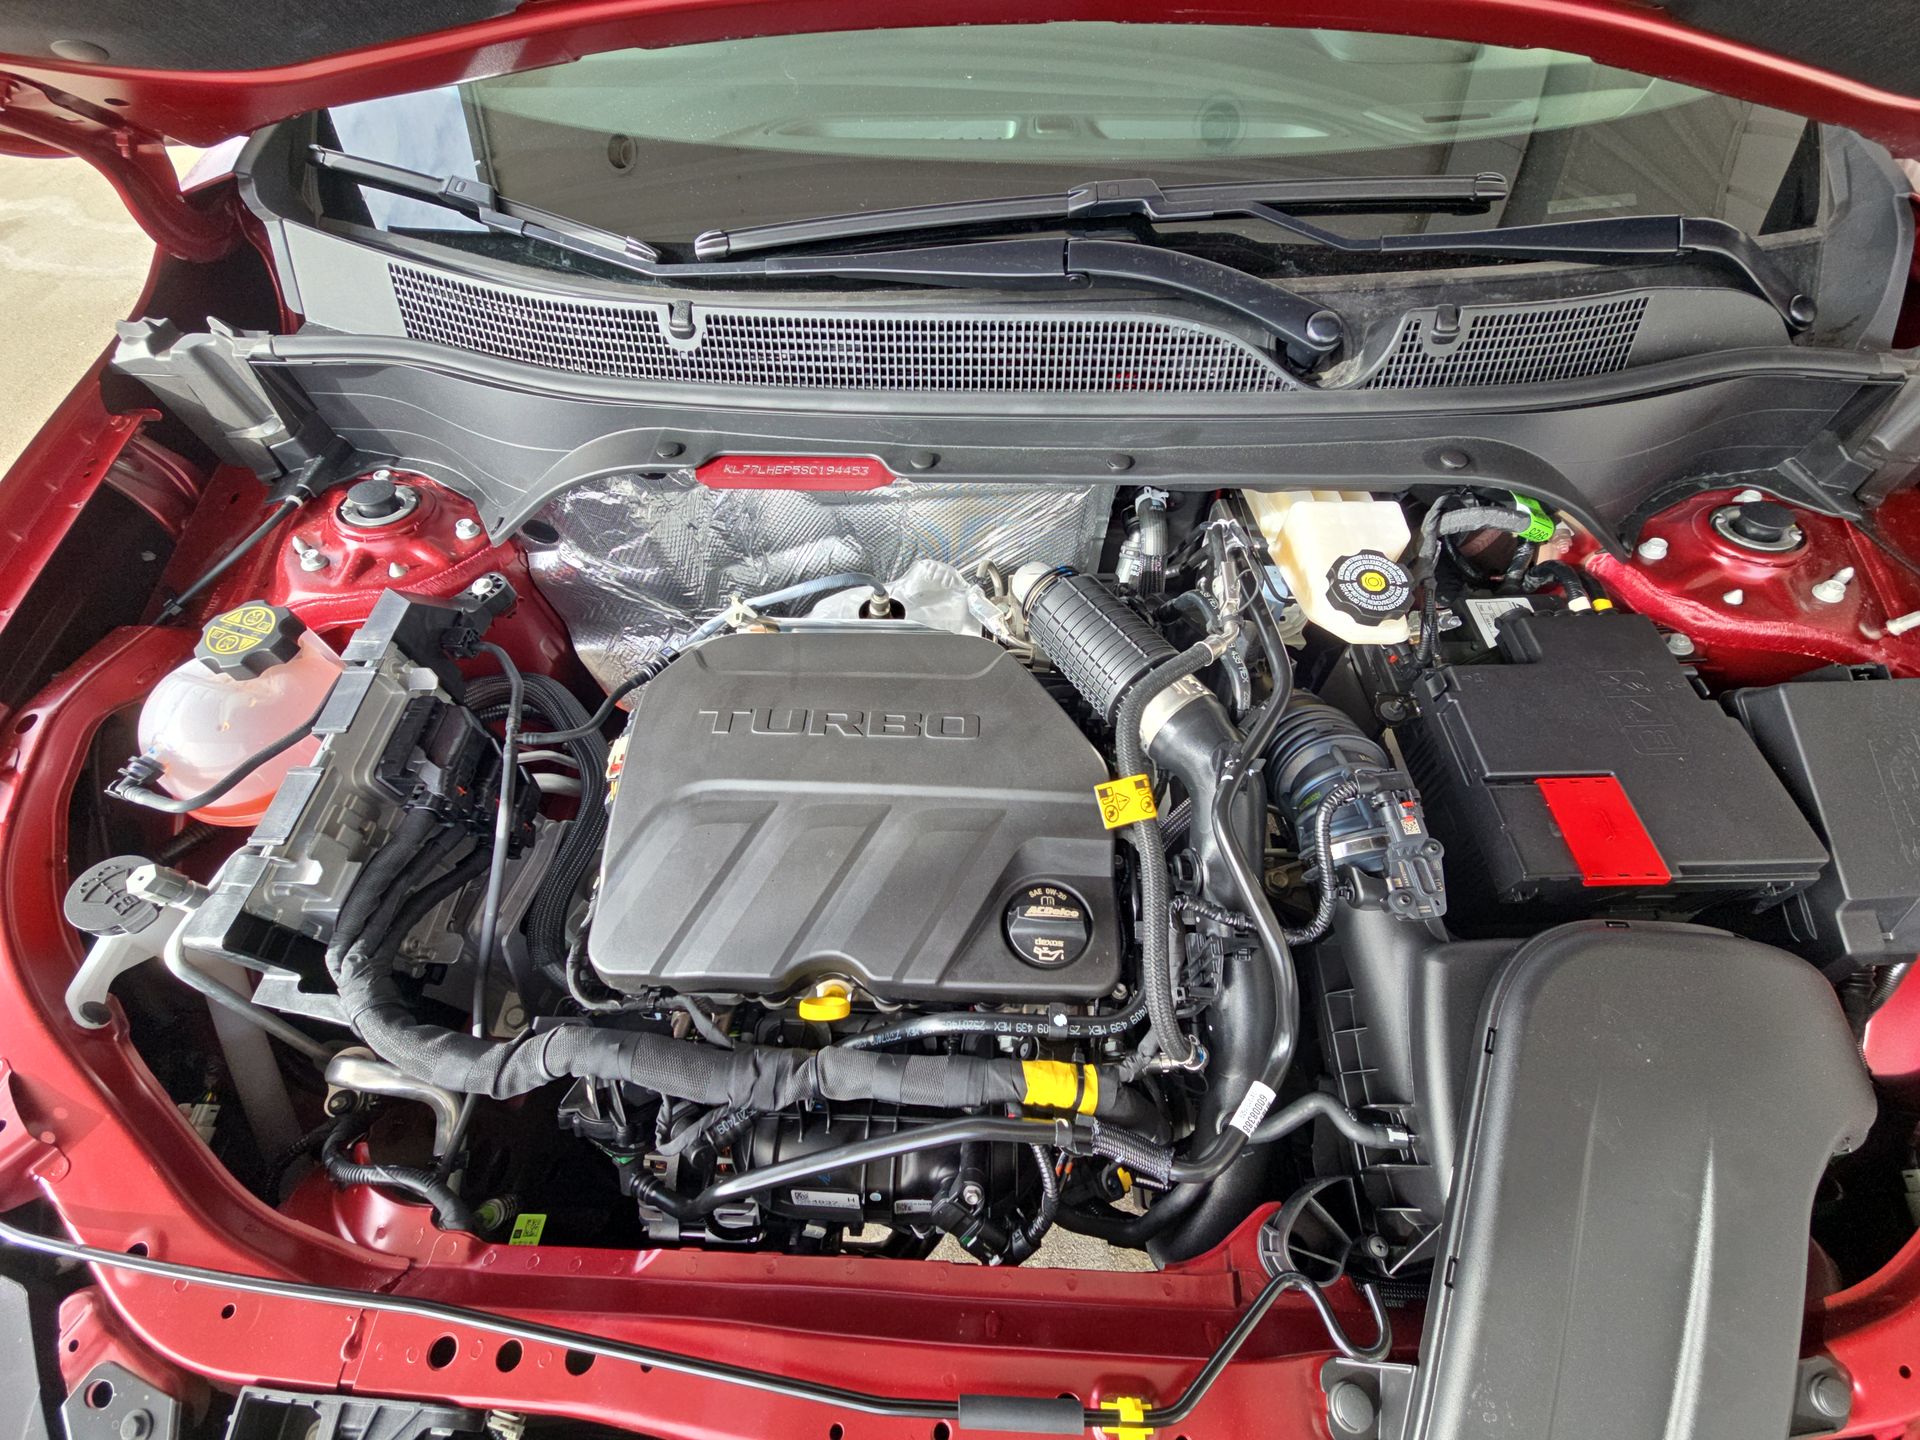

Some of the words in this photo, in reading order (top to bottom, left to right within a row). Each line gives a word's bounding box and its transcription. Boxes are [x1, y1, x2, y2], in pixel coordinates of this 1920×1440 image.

[699, 708, 980, 740] TURBO
[1028, 887, 1043, 898] SAE
[1024, 905, 1079, 918] ACDelco
[1034, 937, 1064, 947] dexos
[993, 1021, 1012, 1032] MEX
[1088, 1024, 1107, 1036] MEX
